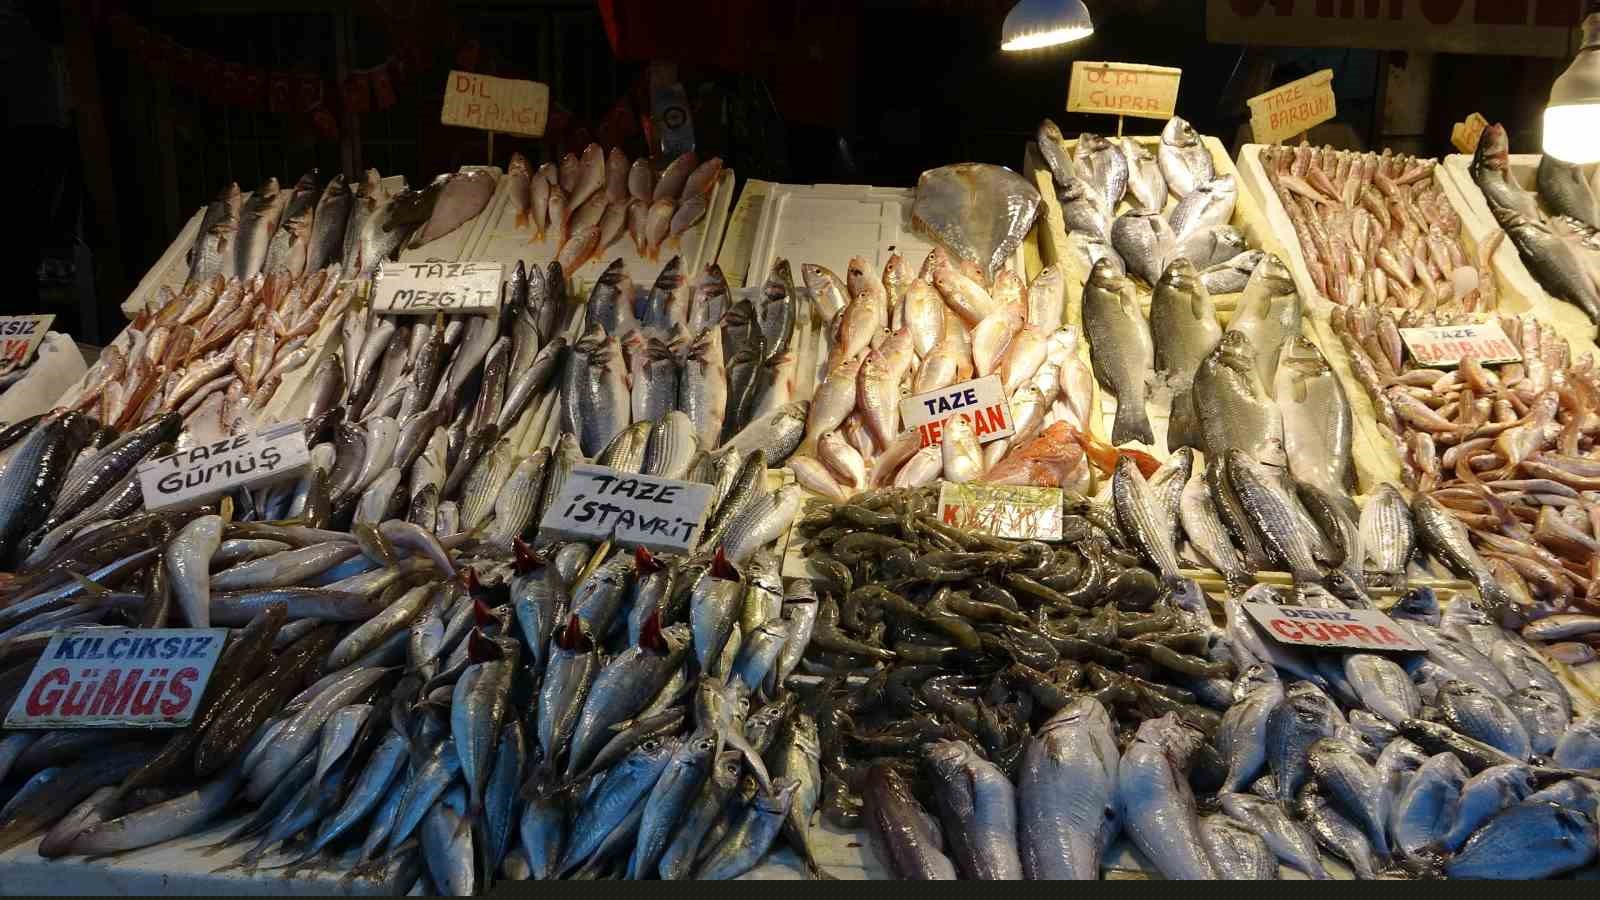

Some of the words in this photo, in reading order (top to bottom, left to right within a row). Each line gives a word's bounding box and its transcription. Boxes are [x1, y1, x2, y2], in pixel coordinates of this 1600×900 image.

[1264, 84, 1305, 112] TAZE
[1269, 95, 1330, 130] BARBUN
[408, 263, 478, 279] TAZE
[388, 287, 494, 311] MEZGİT
[924, 387, 979, 416] TAZE
[159, 433, 251, 468] TAZE
[157, 446, 282, 495] GÜMÜŞ
[591, 475, 685, 504] TAZE
[53, 635, 214, 663] KILÇIKSIZ
